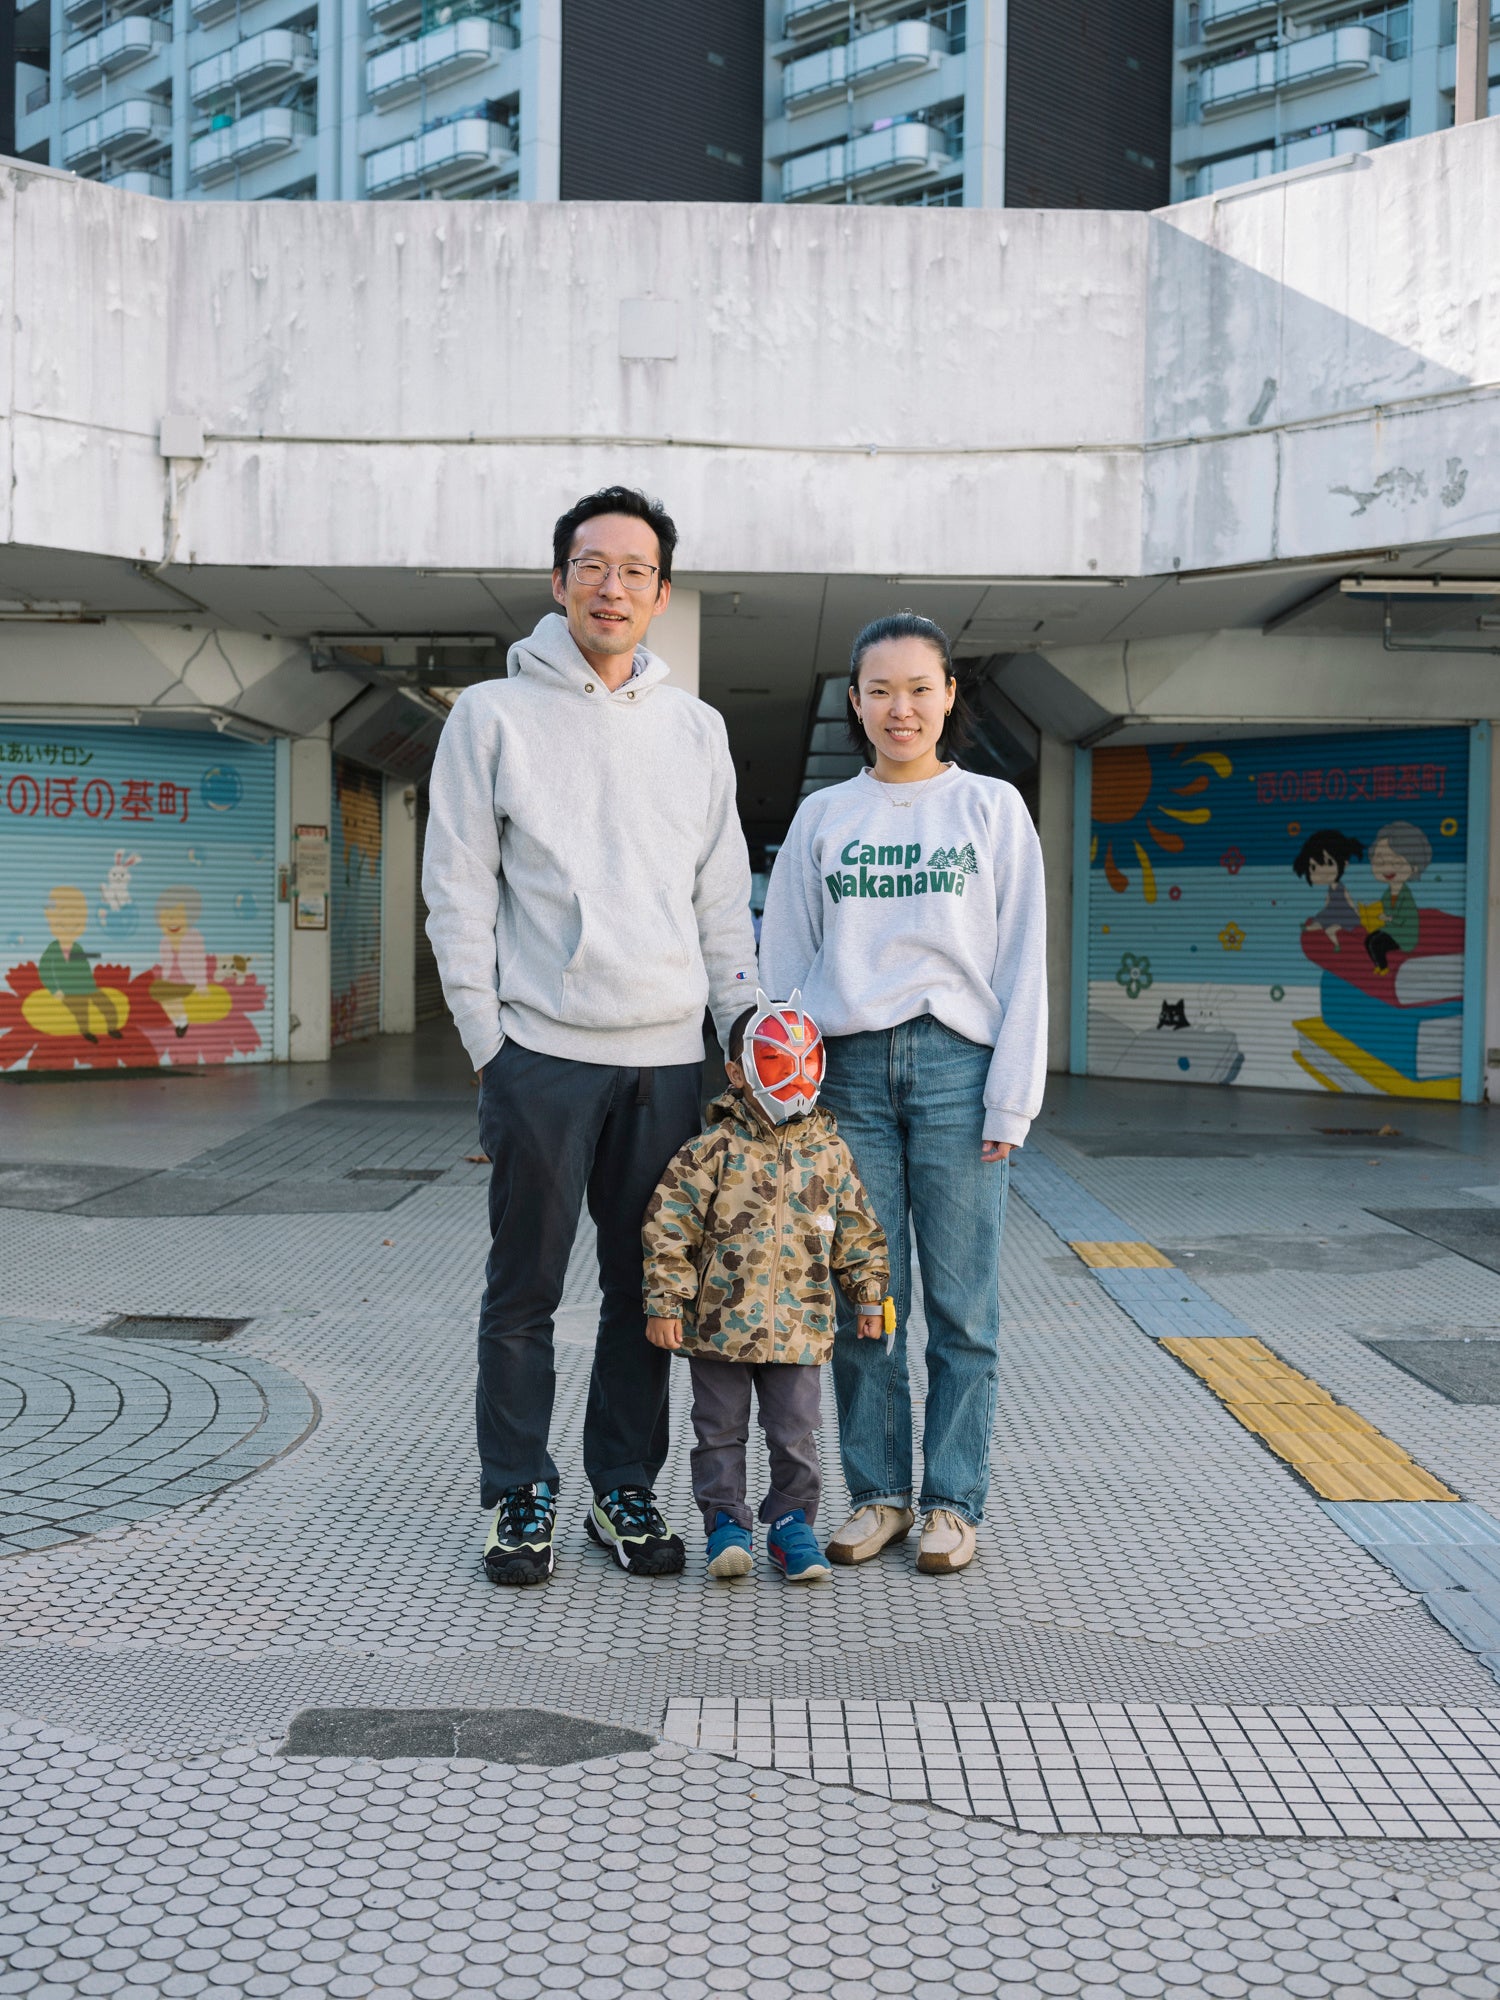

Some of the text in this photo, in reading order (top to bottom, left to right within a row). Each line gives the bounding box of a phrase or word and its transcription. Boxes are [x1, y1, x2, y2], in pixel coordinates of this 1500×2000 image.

[0, 742, 94, 766] あいサロン
[0, 774, 191, 823] のぼの基町
[841, 839, 921, 870] Camp
[824, 866, 965, 904] Nakanawa
